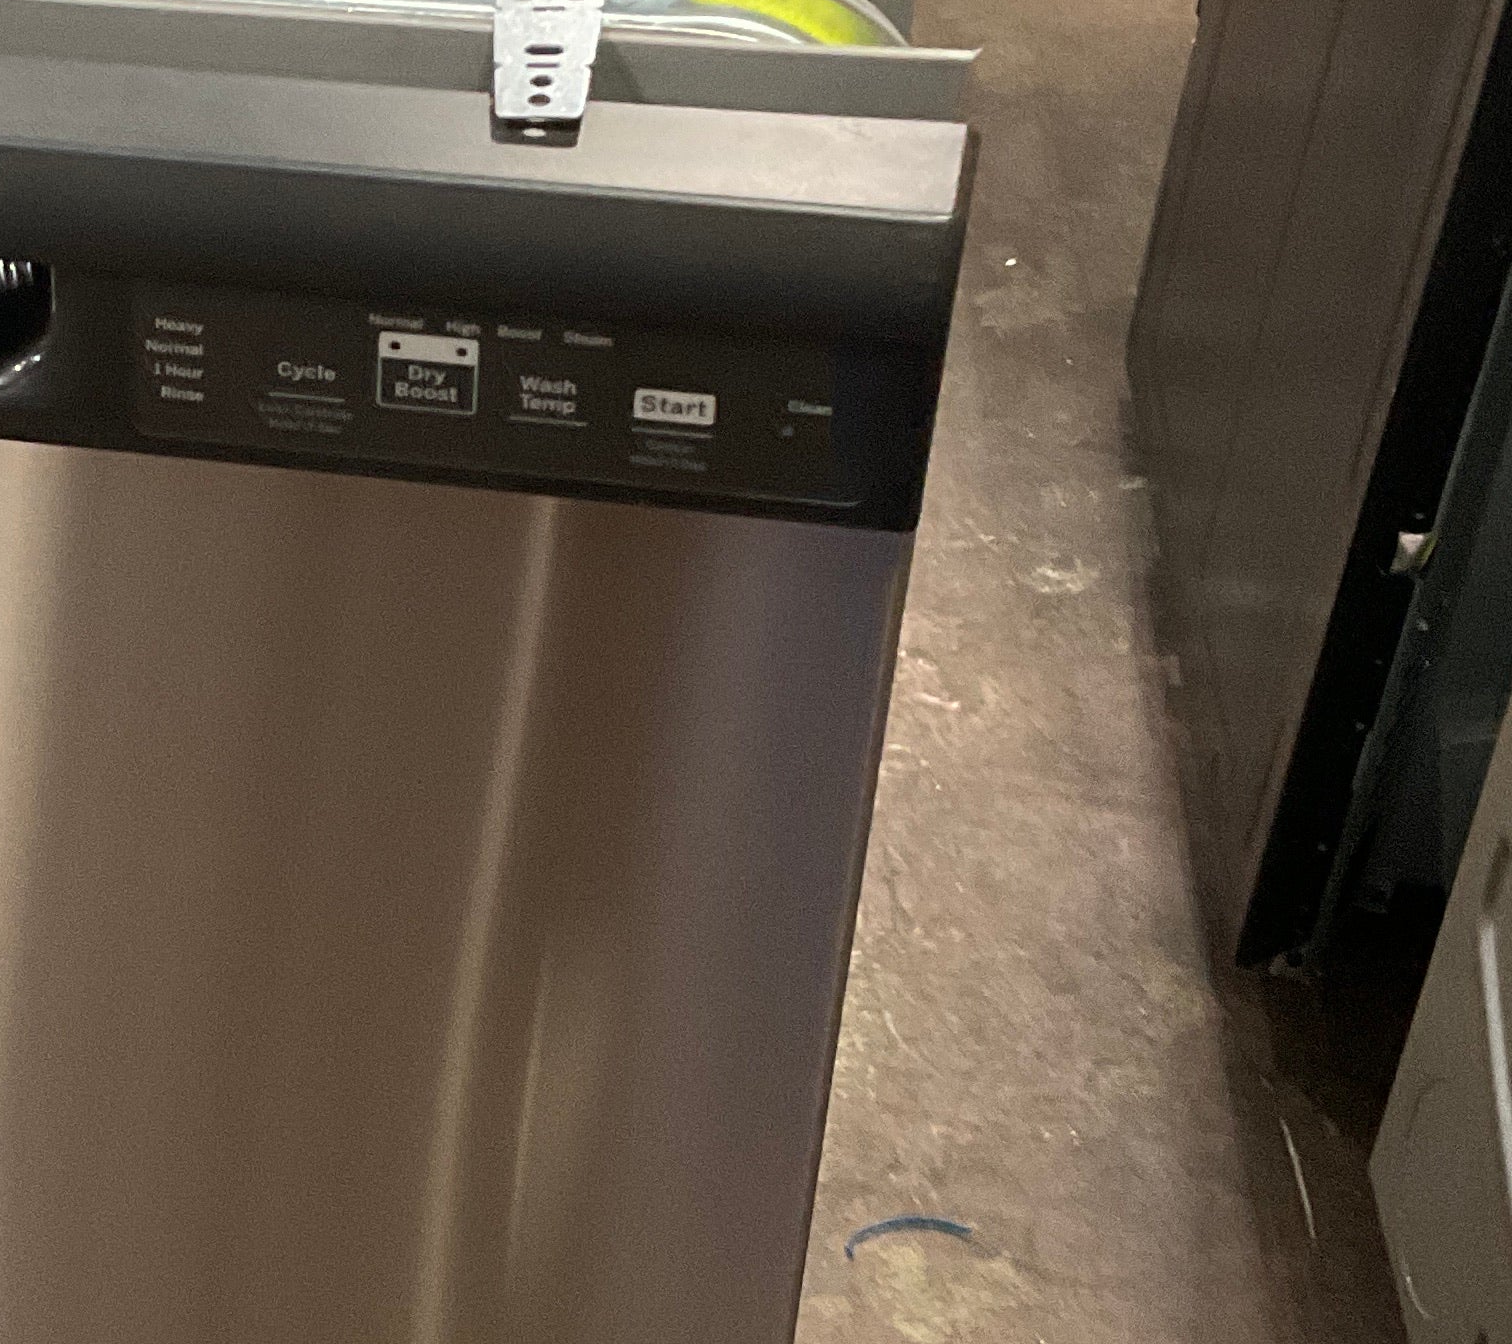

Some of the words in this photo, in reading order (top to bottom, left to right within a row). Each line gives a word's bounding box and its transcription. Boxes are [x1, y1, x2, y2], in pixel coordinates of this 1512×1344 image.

[154, 316, 205, 337] Heavy
[143, 338, 205, 356] Normal
[164, 362, 205, 380] Hour
[276, 360, 337, 382] Cycle
[407, 363, 448, 386] Dry
[160, 384, 206, 402] Rinse
[393, 380, 459, 404] Boost
[518, 374, 578, 397] Wash
[518, 392, 578, 416] Temp
[640, 394, 709, 418] Start
